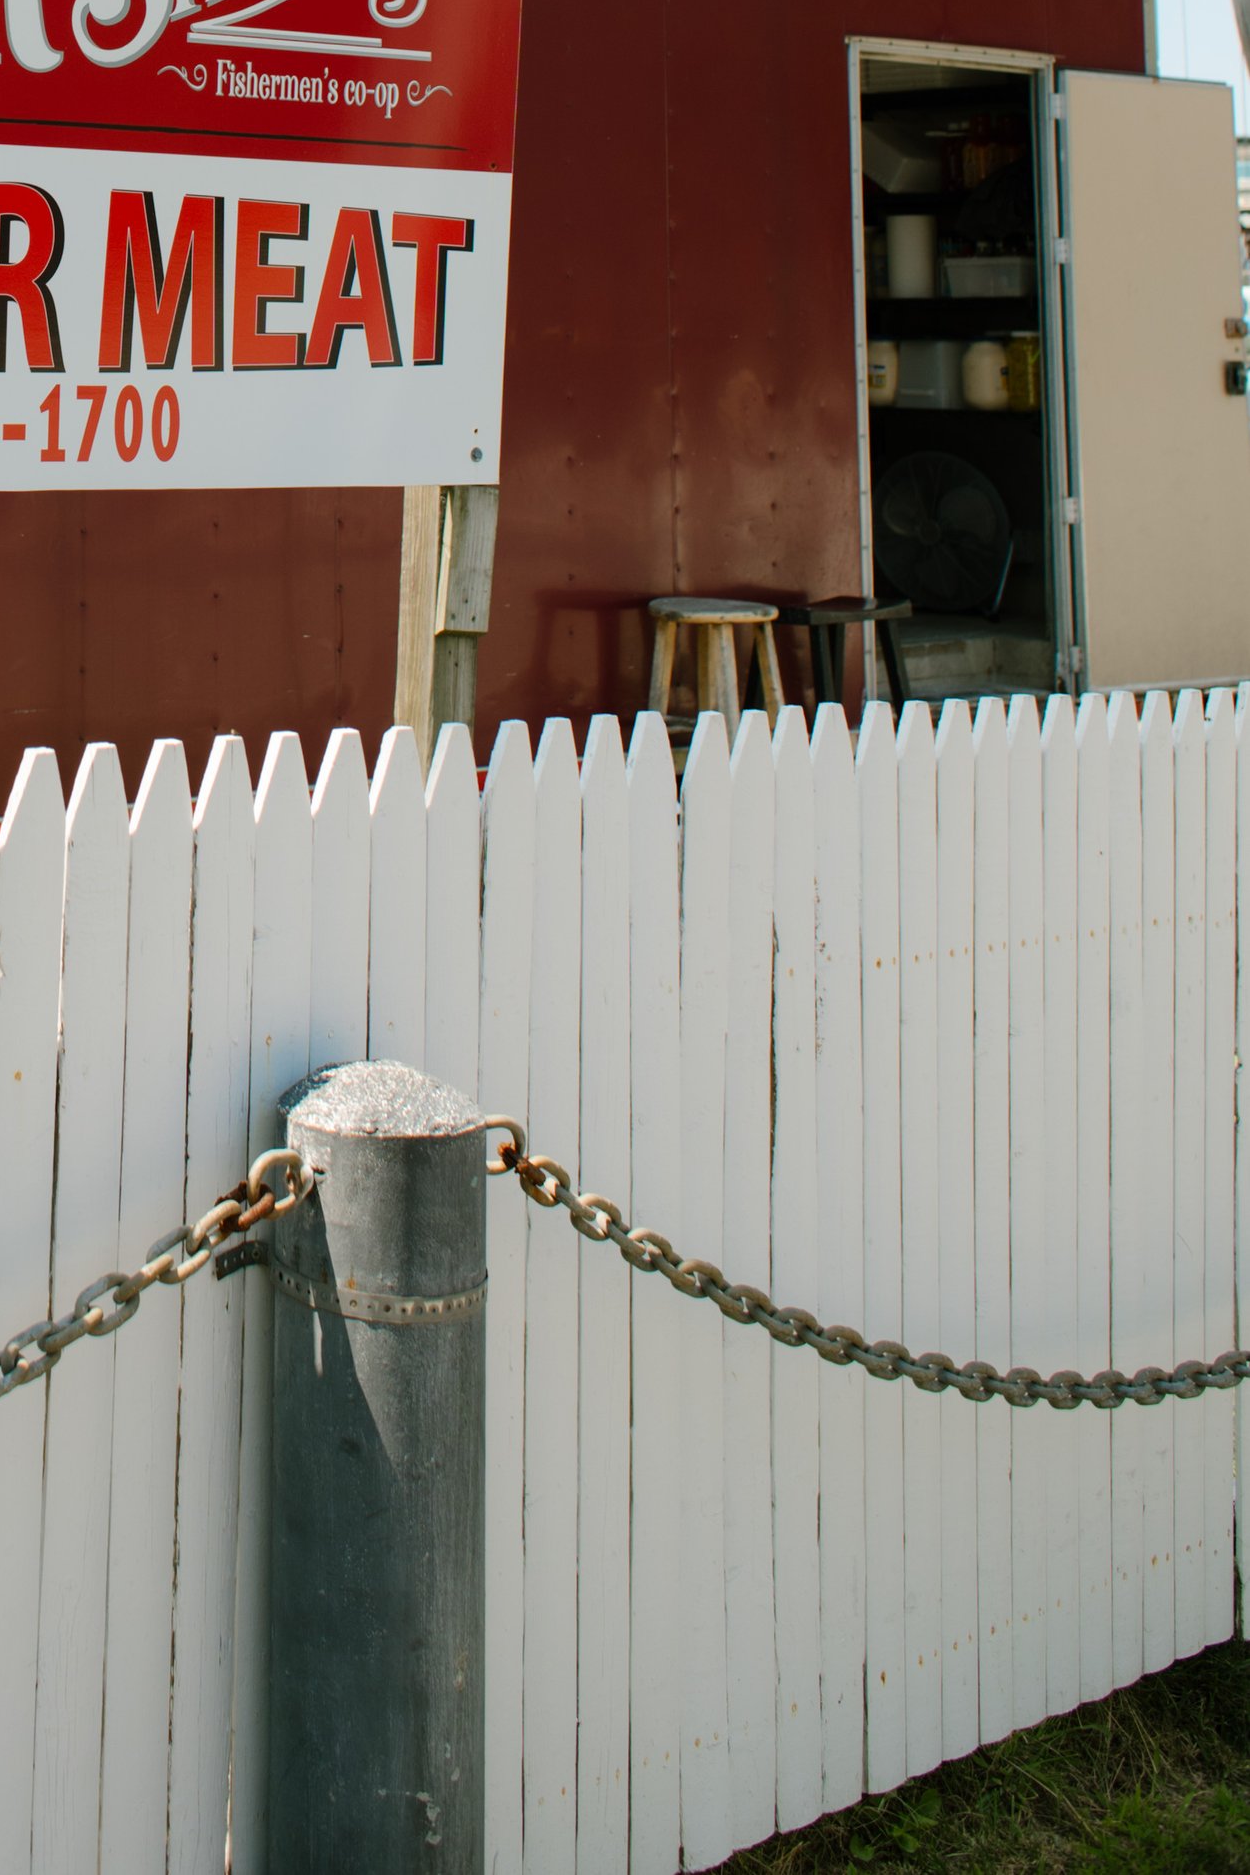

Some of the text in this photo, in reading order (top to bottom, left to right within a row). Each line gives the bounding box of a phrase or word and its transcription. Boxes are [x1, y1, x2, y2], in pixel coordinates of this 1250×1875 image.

[214, 58, 401, 119] Fishermen's co-op
[98, 188, 475, 373] MEAT
